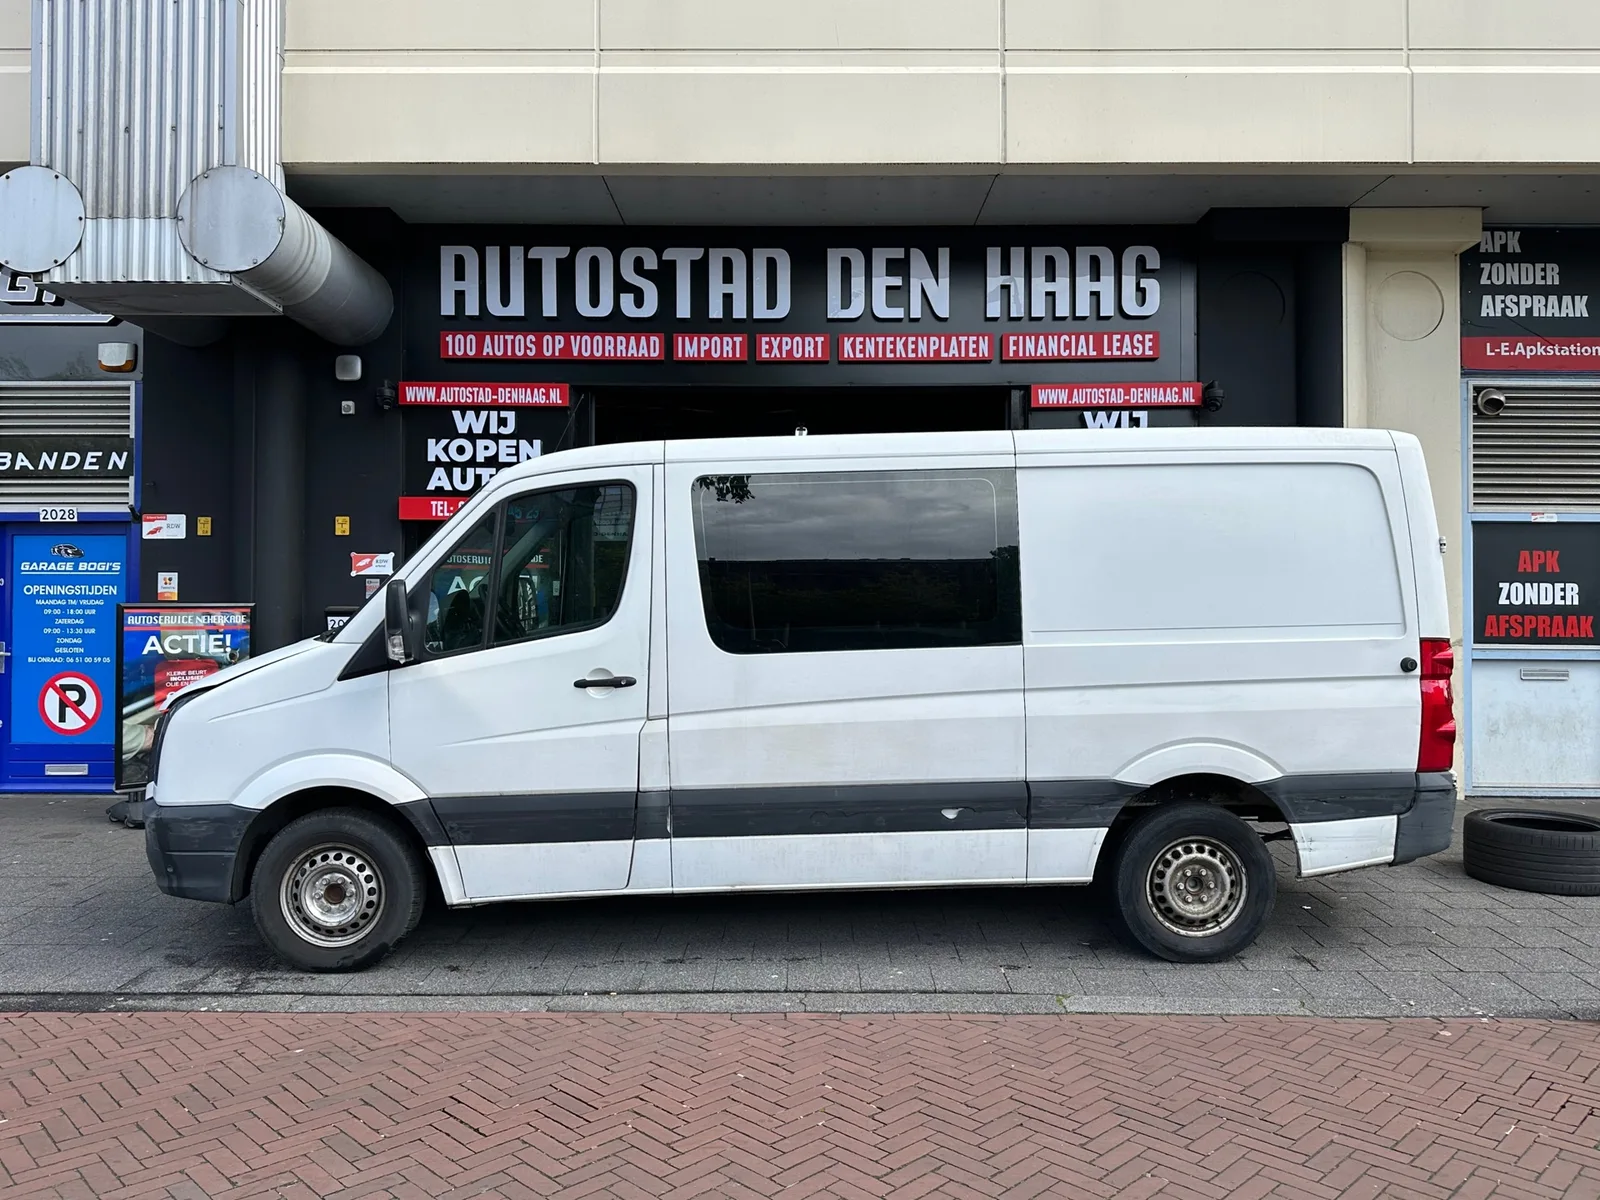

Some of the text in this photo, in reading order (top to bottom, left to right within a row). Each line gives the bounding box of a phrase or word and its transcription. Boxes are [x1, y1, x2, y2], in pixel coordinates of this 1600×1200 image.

[1480, 231, 1521, 253] APK
[440, 245, 1161, 319] AUTOSTAD DEN HAAG
[1480, 263, 1560, 285] ZONDER
[1480, 295, 1589, 318] AFSPRAAK
[445, 333, 660, 357] 100 AUTOS OP VOORRAAD
[677, 336, 743, 359] IMPORT
[761, 336, 825, 359] EXPORT
[843, 335, 990, 359] KENTEKENPLATEN
[1008, 333, 1154, 358] FINANCIAL LEASE
[405, 386, 562, 404] WWW.AUTOSTAD-DENHAAG.NL
[1037, 387, 1195, 405] WWW.AUTOSTAD-DENHAAG.NL
[452, 410, 516, 435] WIJ
[1083, 410, 1148, 428] WIJ
[0, 451, 128, 471] BANDEN
[427, 438, 542, 463] KOPEN
[426, 467, 497, 491] AUT
[41, 509, 76, 520] 2028
[430, 501, 454, 516] TEL:
[20, 562, 121, 571] GARAGE BOGI'S
[1517, 550, 1560, 573] APK
[23, 585, 117, 595] OPENINGSTIJDEN
[1498, 582, 1579, 605] ZONDER
[1485, 615, 1594, 637] AFSPRAAK
[142, 634, 231, 655] ACTIE!
